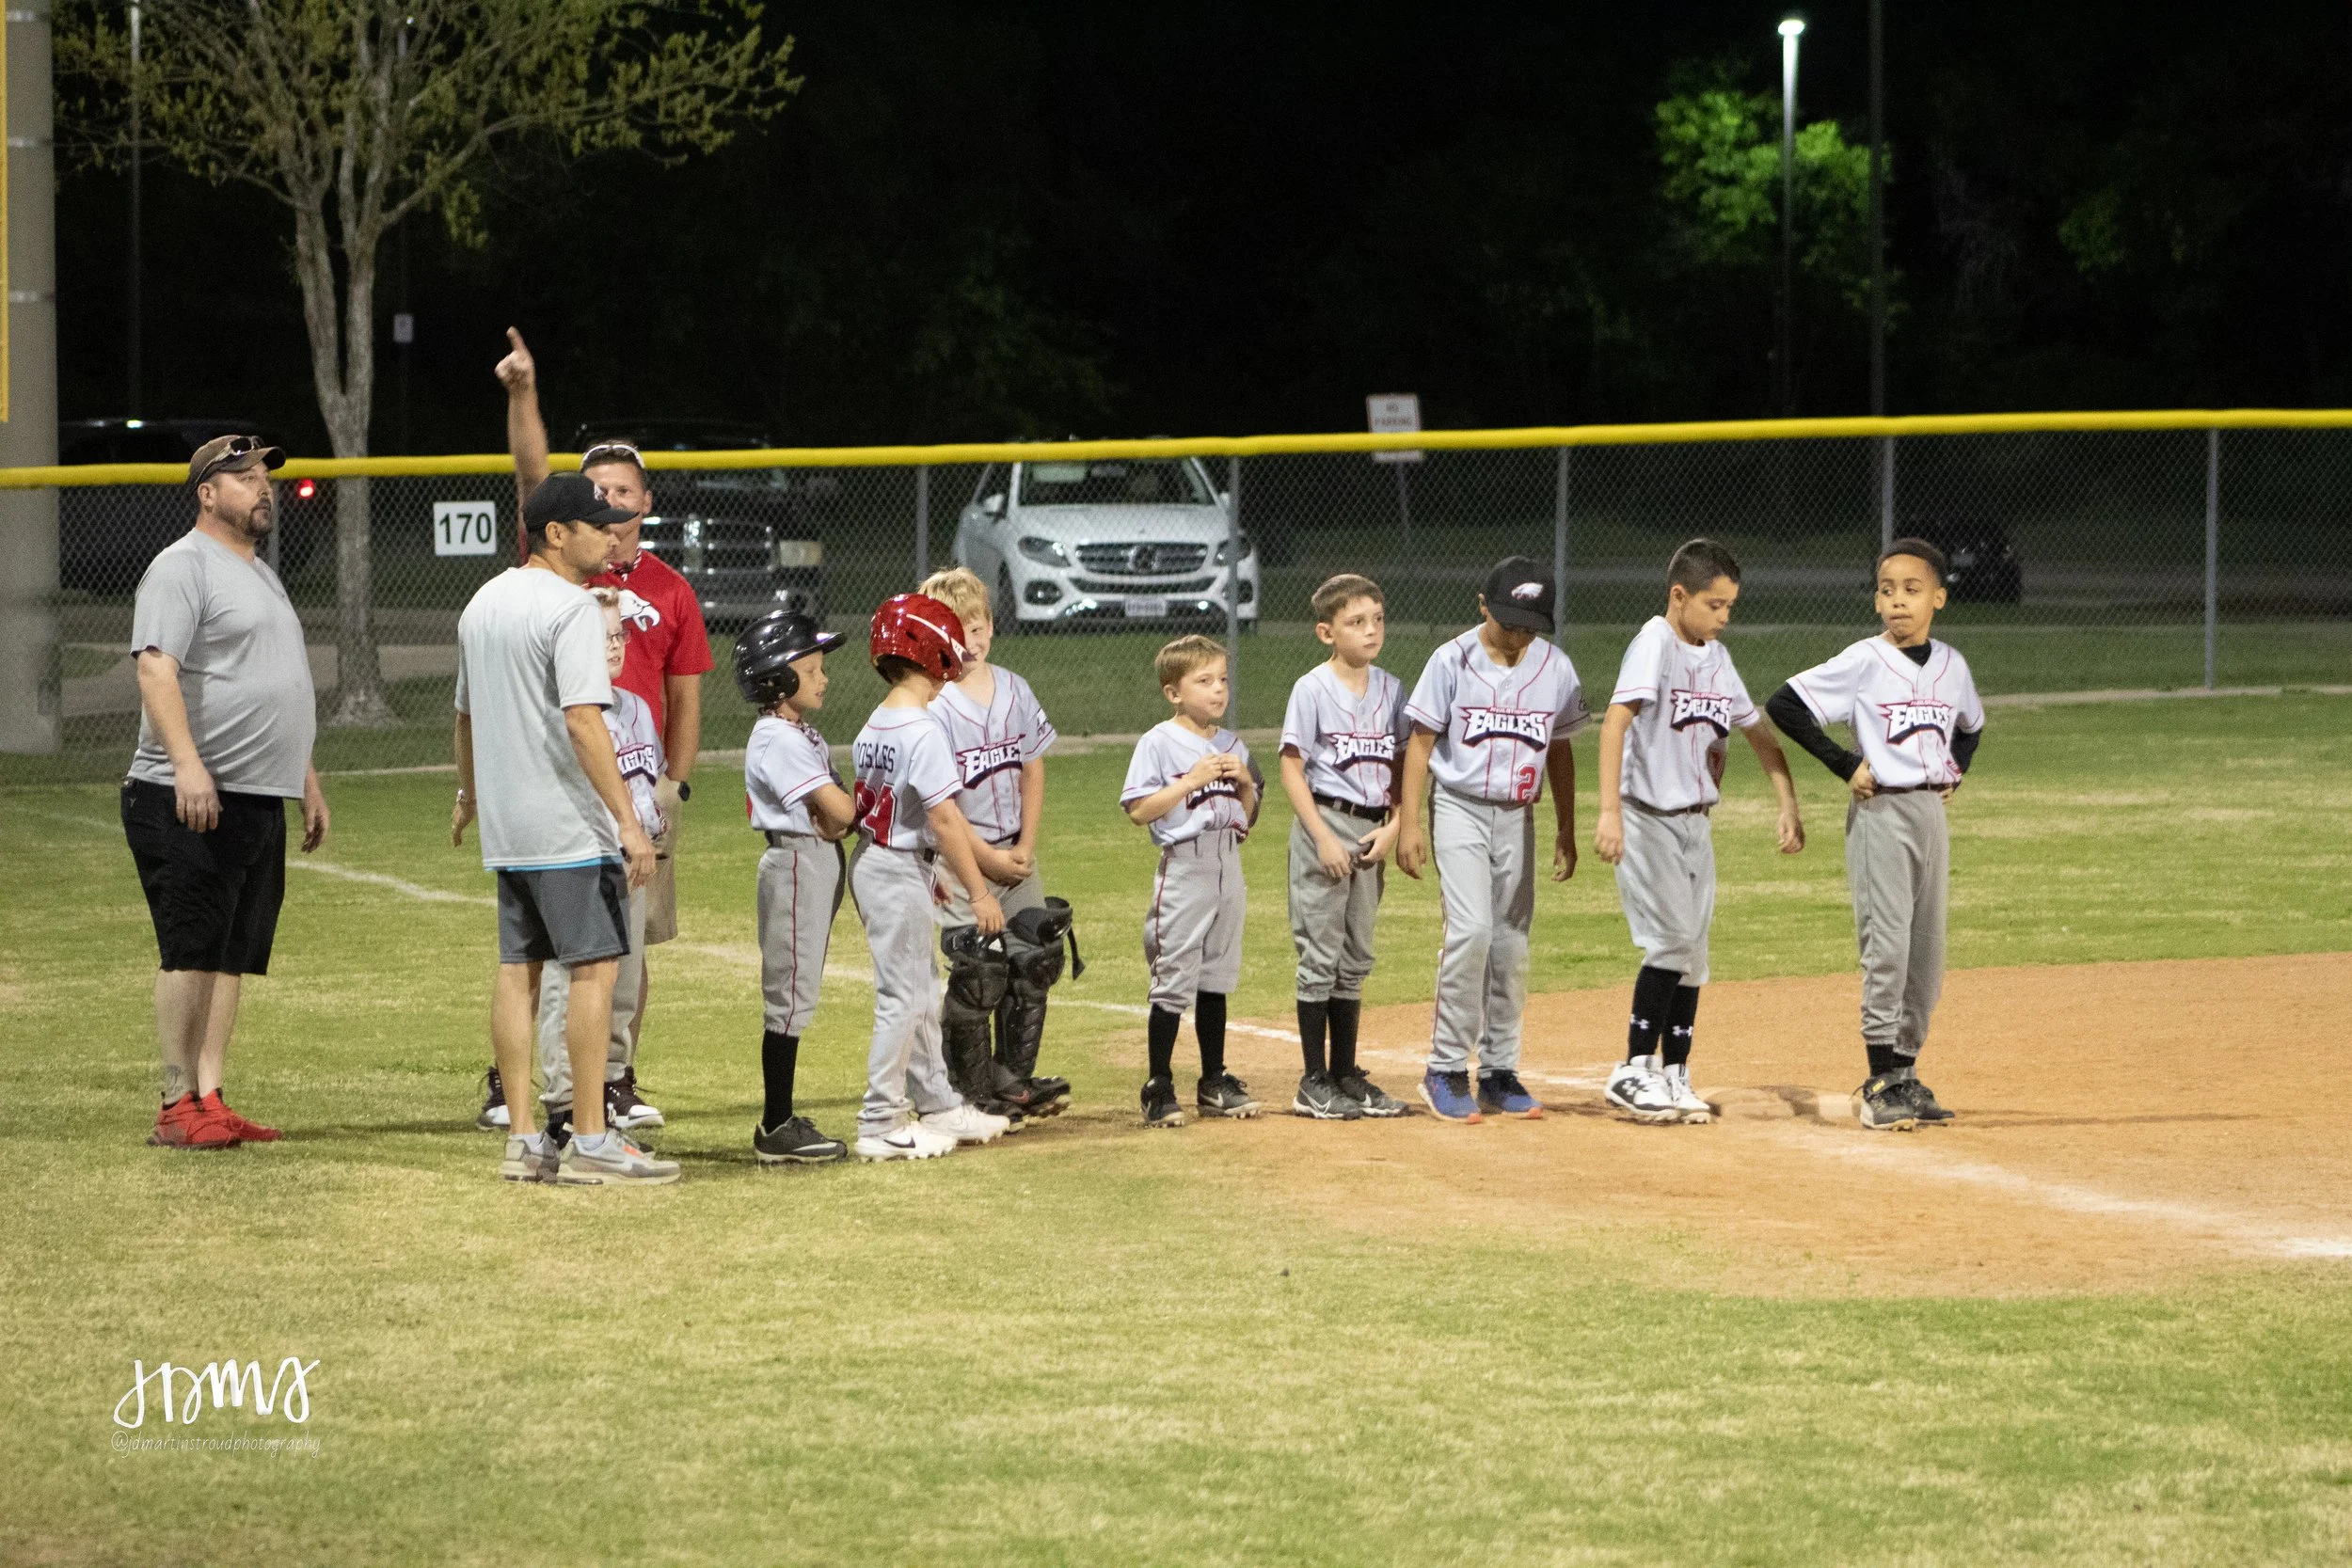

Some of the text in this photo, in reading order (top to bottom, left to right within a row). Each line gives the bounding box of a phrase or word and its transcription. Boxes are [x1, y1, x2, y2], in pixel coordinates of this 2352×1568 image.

[439, 513, 492, 545] 170
[1464, 707, 1549, 747] EAGLES
[961, 738, 1022, 784] EAGLE
[1516, 765, 1540, 805] 2
